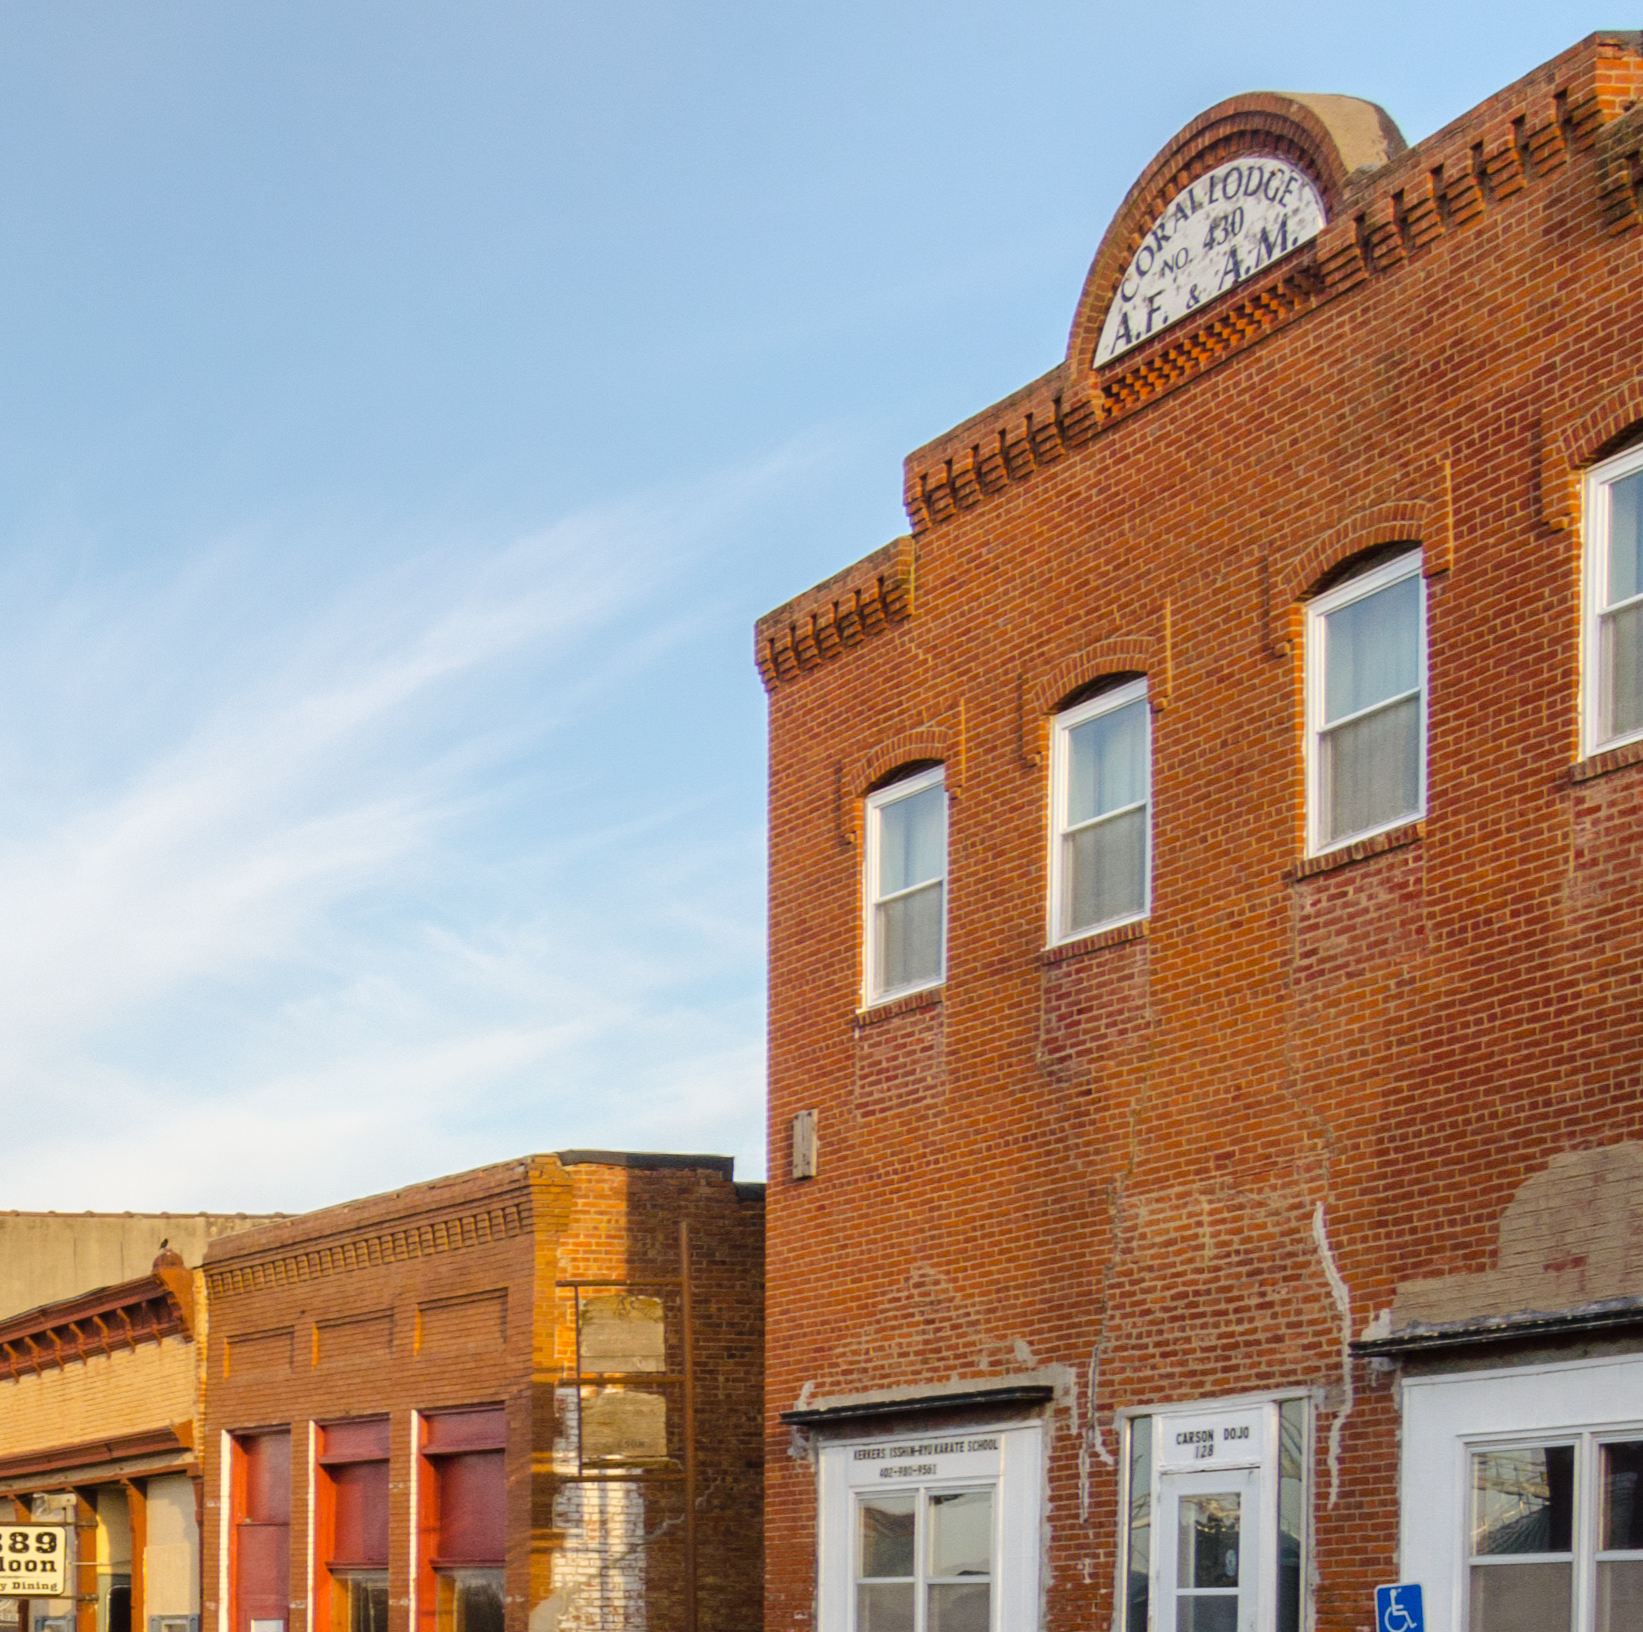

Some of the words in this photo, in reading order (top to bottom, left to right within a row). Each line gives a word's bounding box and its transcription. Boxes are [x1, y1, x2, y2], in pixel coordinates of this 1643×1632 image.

[1120, 187, 1198, 303] CORAL
[1208, 166, 1298, 208] LODGE
[1203, 206, 1244, 250] 430
[1186, 283, 1201, 310] &
[1217, 212, 1299, 292] A.M.
[1176, 1429, 1215, 1445] CARSON
[1223, 1426, 1250, 1441] DOJO
[934, 1440, 965, 1455] KARATE
[967, 1438, 999, 1451] SCHOOL
[1195, 1444, 1214, 1459] 128
[12, 1581, 58, 1592] Dining
